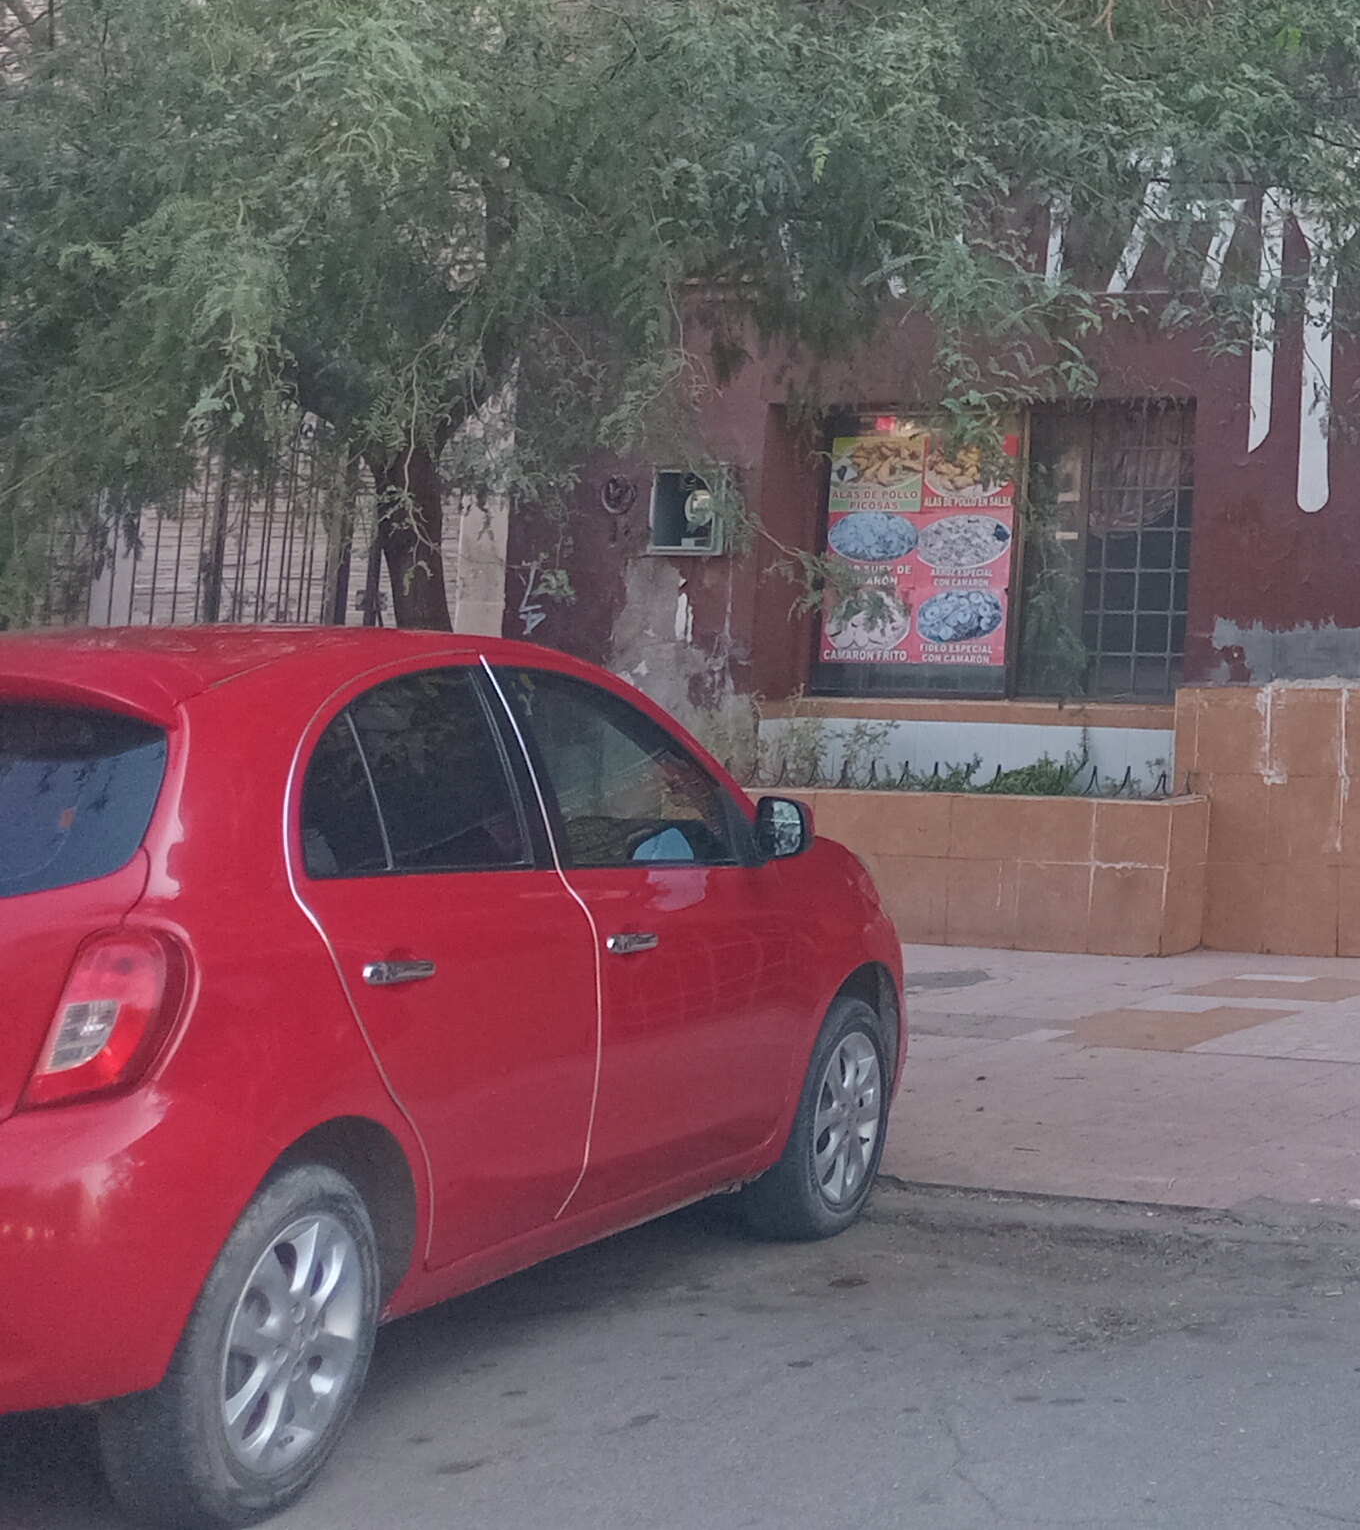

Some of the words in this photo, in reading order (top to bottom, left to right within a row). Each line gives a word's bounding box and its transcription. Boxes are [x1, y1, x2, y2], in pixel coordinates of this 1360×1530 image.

[831, 490, 861, 499] ALAS
[864, 490, 877, 499] DE
[881, 490, 918, 499] POLLO
[850, 500, 899, 510] PICOSAS
[924, 496, 942, 507] ALAS
[954, 496, 977, 507] POLLO
[978, 496, 988, 507] EN
[989, 496, 1012, 507] SALSA
[897, 565, 912, 574] DE
[957, 568, 993, 577] ESPECIAL
[934, 577, 950, 587] CON
[877, 649, 908, 661] FRITO
[948, 645, 993, 655] ESPECIAL
[921, 653, 942, 664] CON
